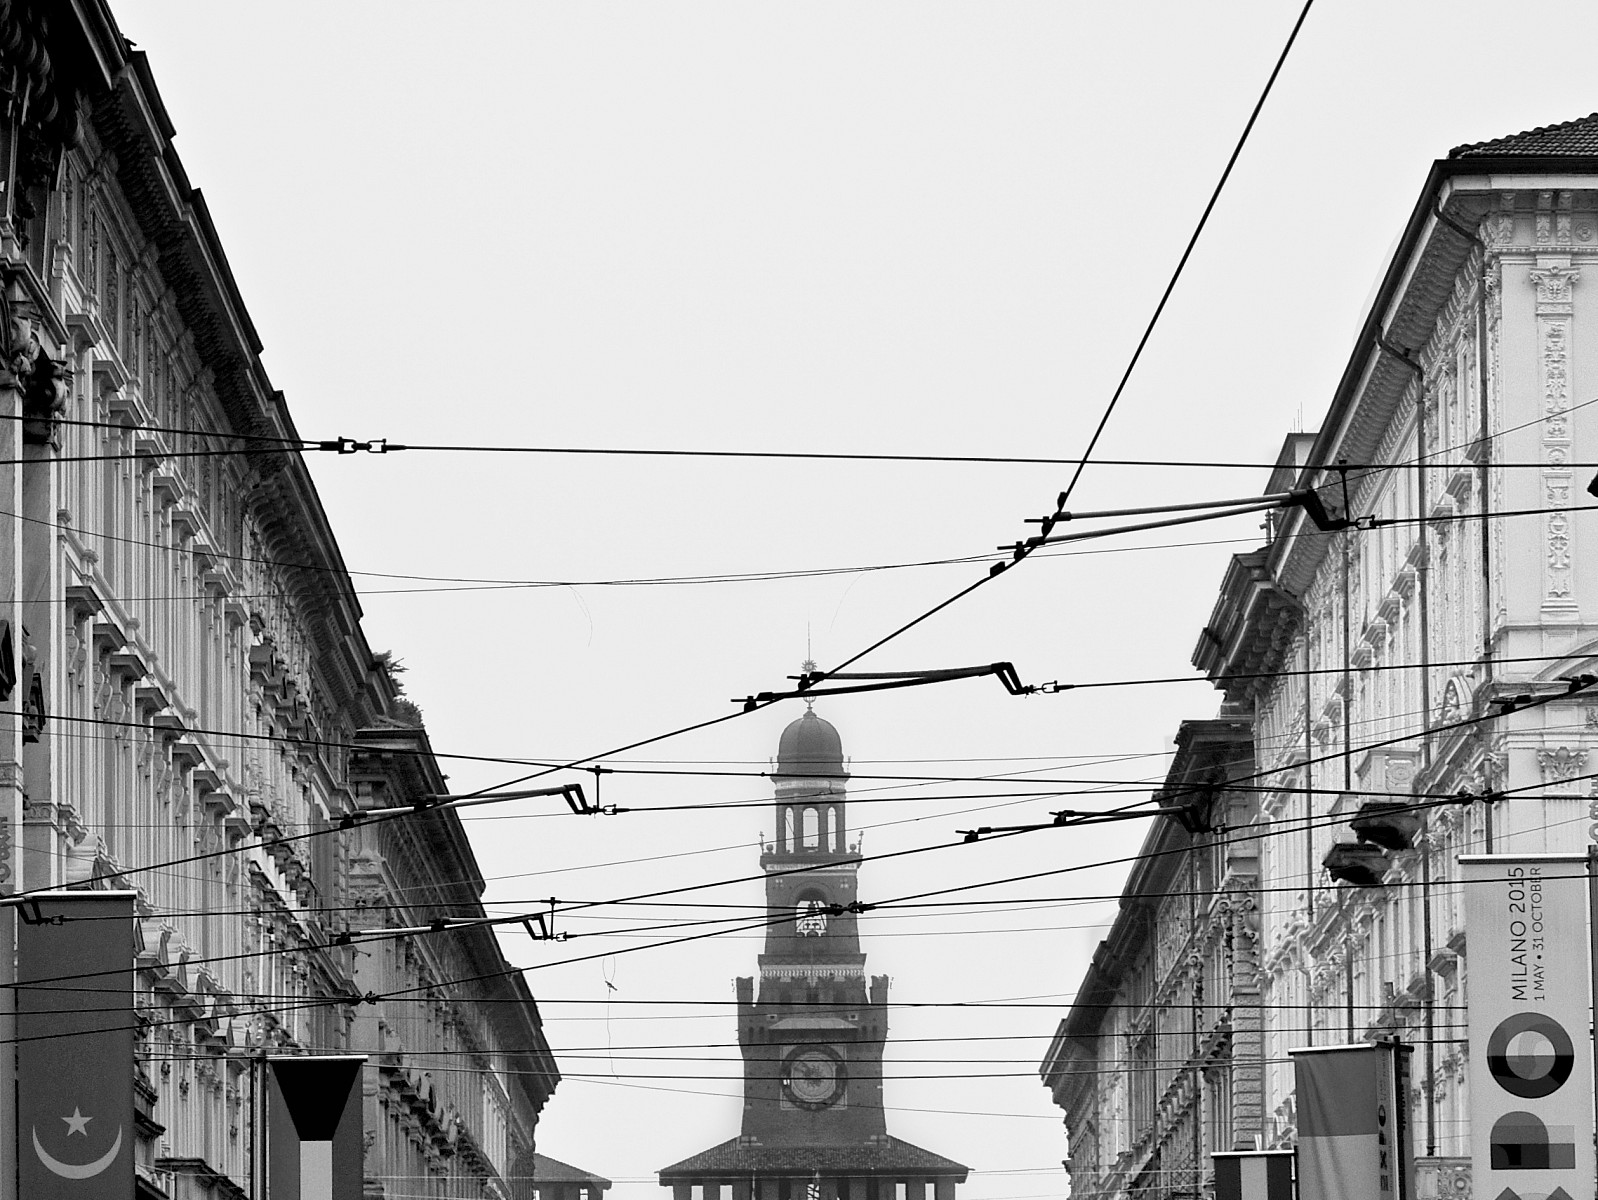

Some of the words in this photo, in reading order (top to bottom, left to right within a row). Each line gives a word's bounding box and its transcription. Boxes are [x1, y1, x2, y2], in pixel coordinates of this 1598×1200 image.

[1507, 867, 1525, 914] 2015
[1529, 866, 1544, 933] OCTOBER
[1509, 920, 1528, 1000] MILANO
[1532, 936, 1545, 951] 31
[1533, 963, 1545, 991] MAY
